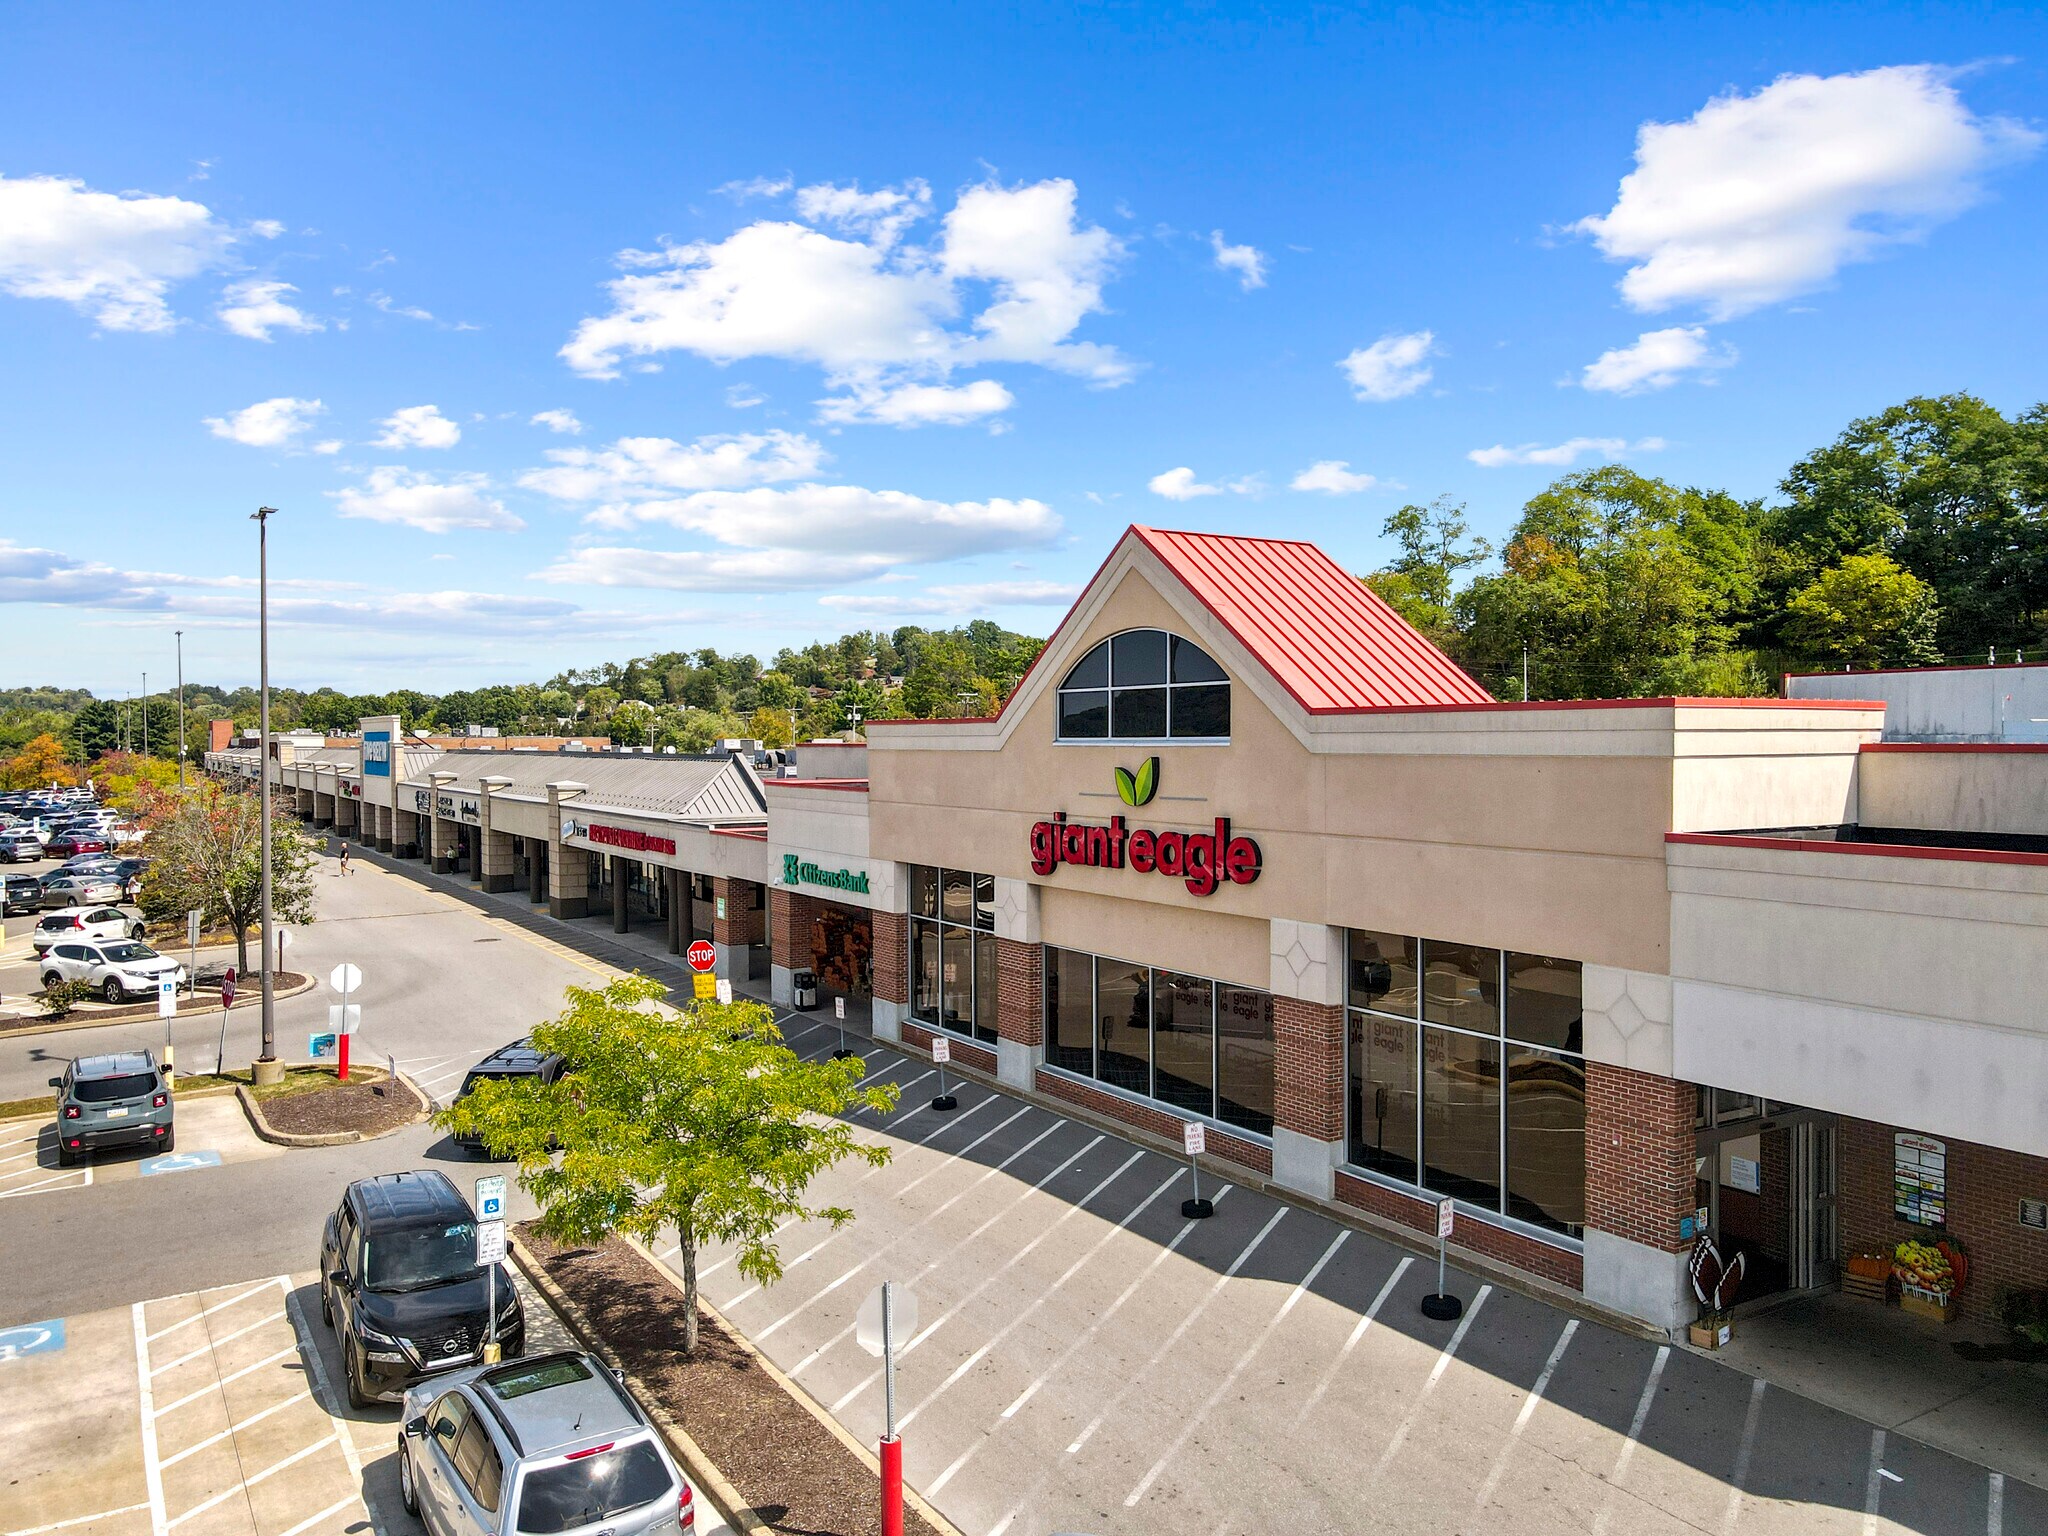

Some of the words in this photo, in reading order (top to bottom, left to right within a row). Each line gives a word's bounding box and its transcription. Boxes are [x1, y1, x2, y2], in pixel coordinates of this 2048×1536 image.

[1030, 811, 1129, 875] giant
[1129, 817, 1262, 897] eagle
[690, 949, 714, 963] STOP
[223, 979, 235, 997] STOP
[1233, 992, 1258, 1006] giant
[1233, 1005, 1258, 1020] eagle
[1374, 1021, 1404, 1038] giant
[1374, 1036, 1404, 1053] eagle
